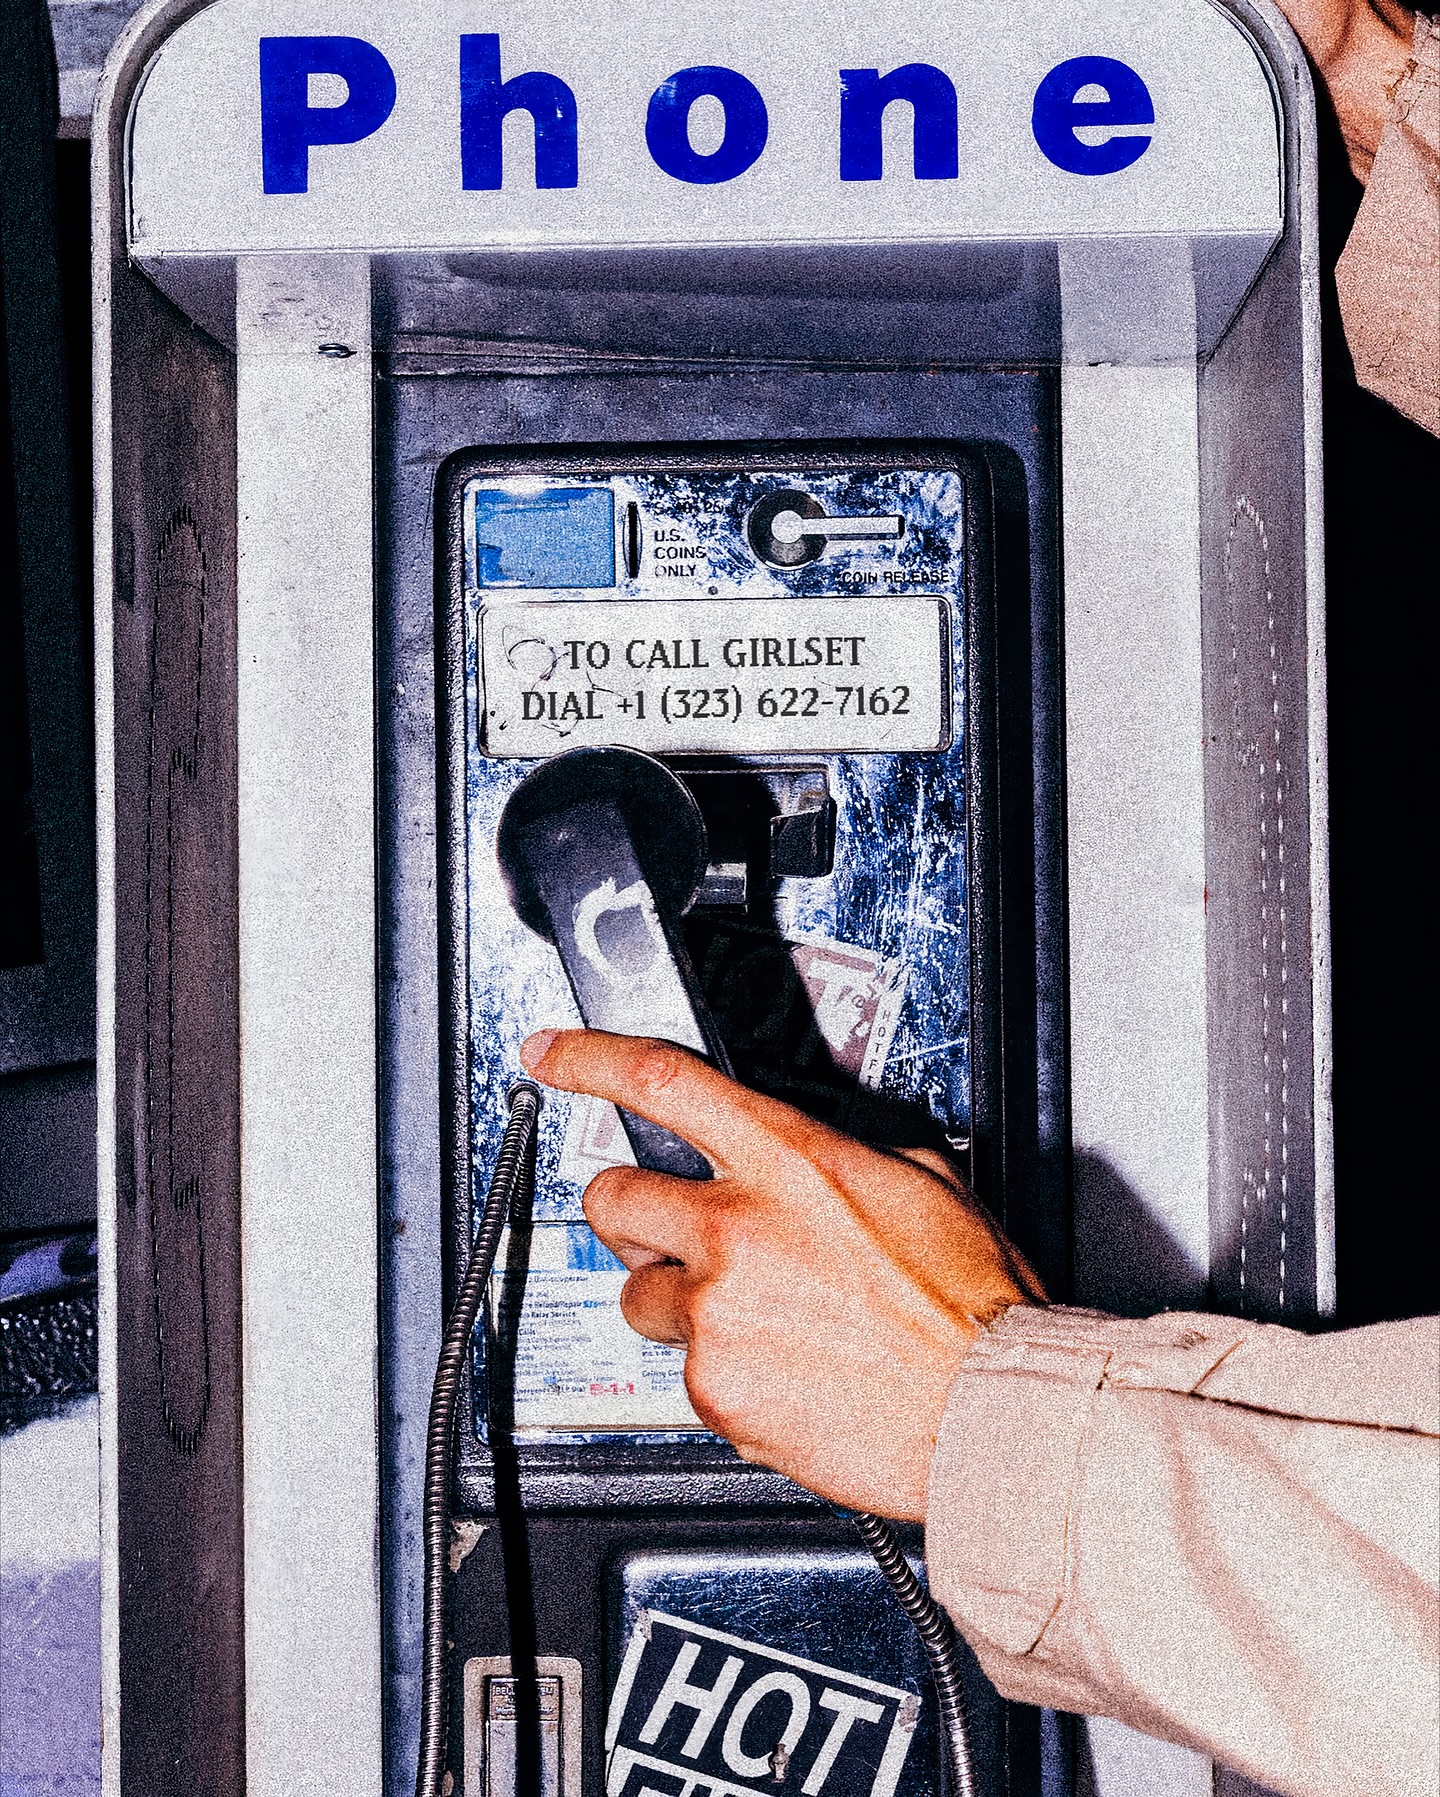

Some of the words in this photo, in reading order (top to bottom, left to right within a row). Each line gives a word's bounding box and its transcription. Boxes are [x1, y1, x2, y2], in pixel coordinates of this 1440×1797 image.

[261, 33, 1155, 195] Phone
[654, 528, 685, 542] U.S.
[654, 546, 707, 559] COINS
[654, 564, 697, 577] ONLY
[842, 571, 878, 584] COIN
[883, 570, 950, 584] RELEASE
[564, 640, 610, 670] TO
[626, 639, 710, 670] CALL
[723, 637, 866, 669] GIRLSET
[521, 690, 604, 722] DIAL
[617, 690, 646, 720] +1
[661, 685, 742, 724] (323)
[757, 686, 911, 718] 622-7162
[638, 1640, 886, 1797] HOT
